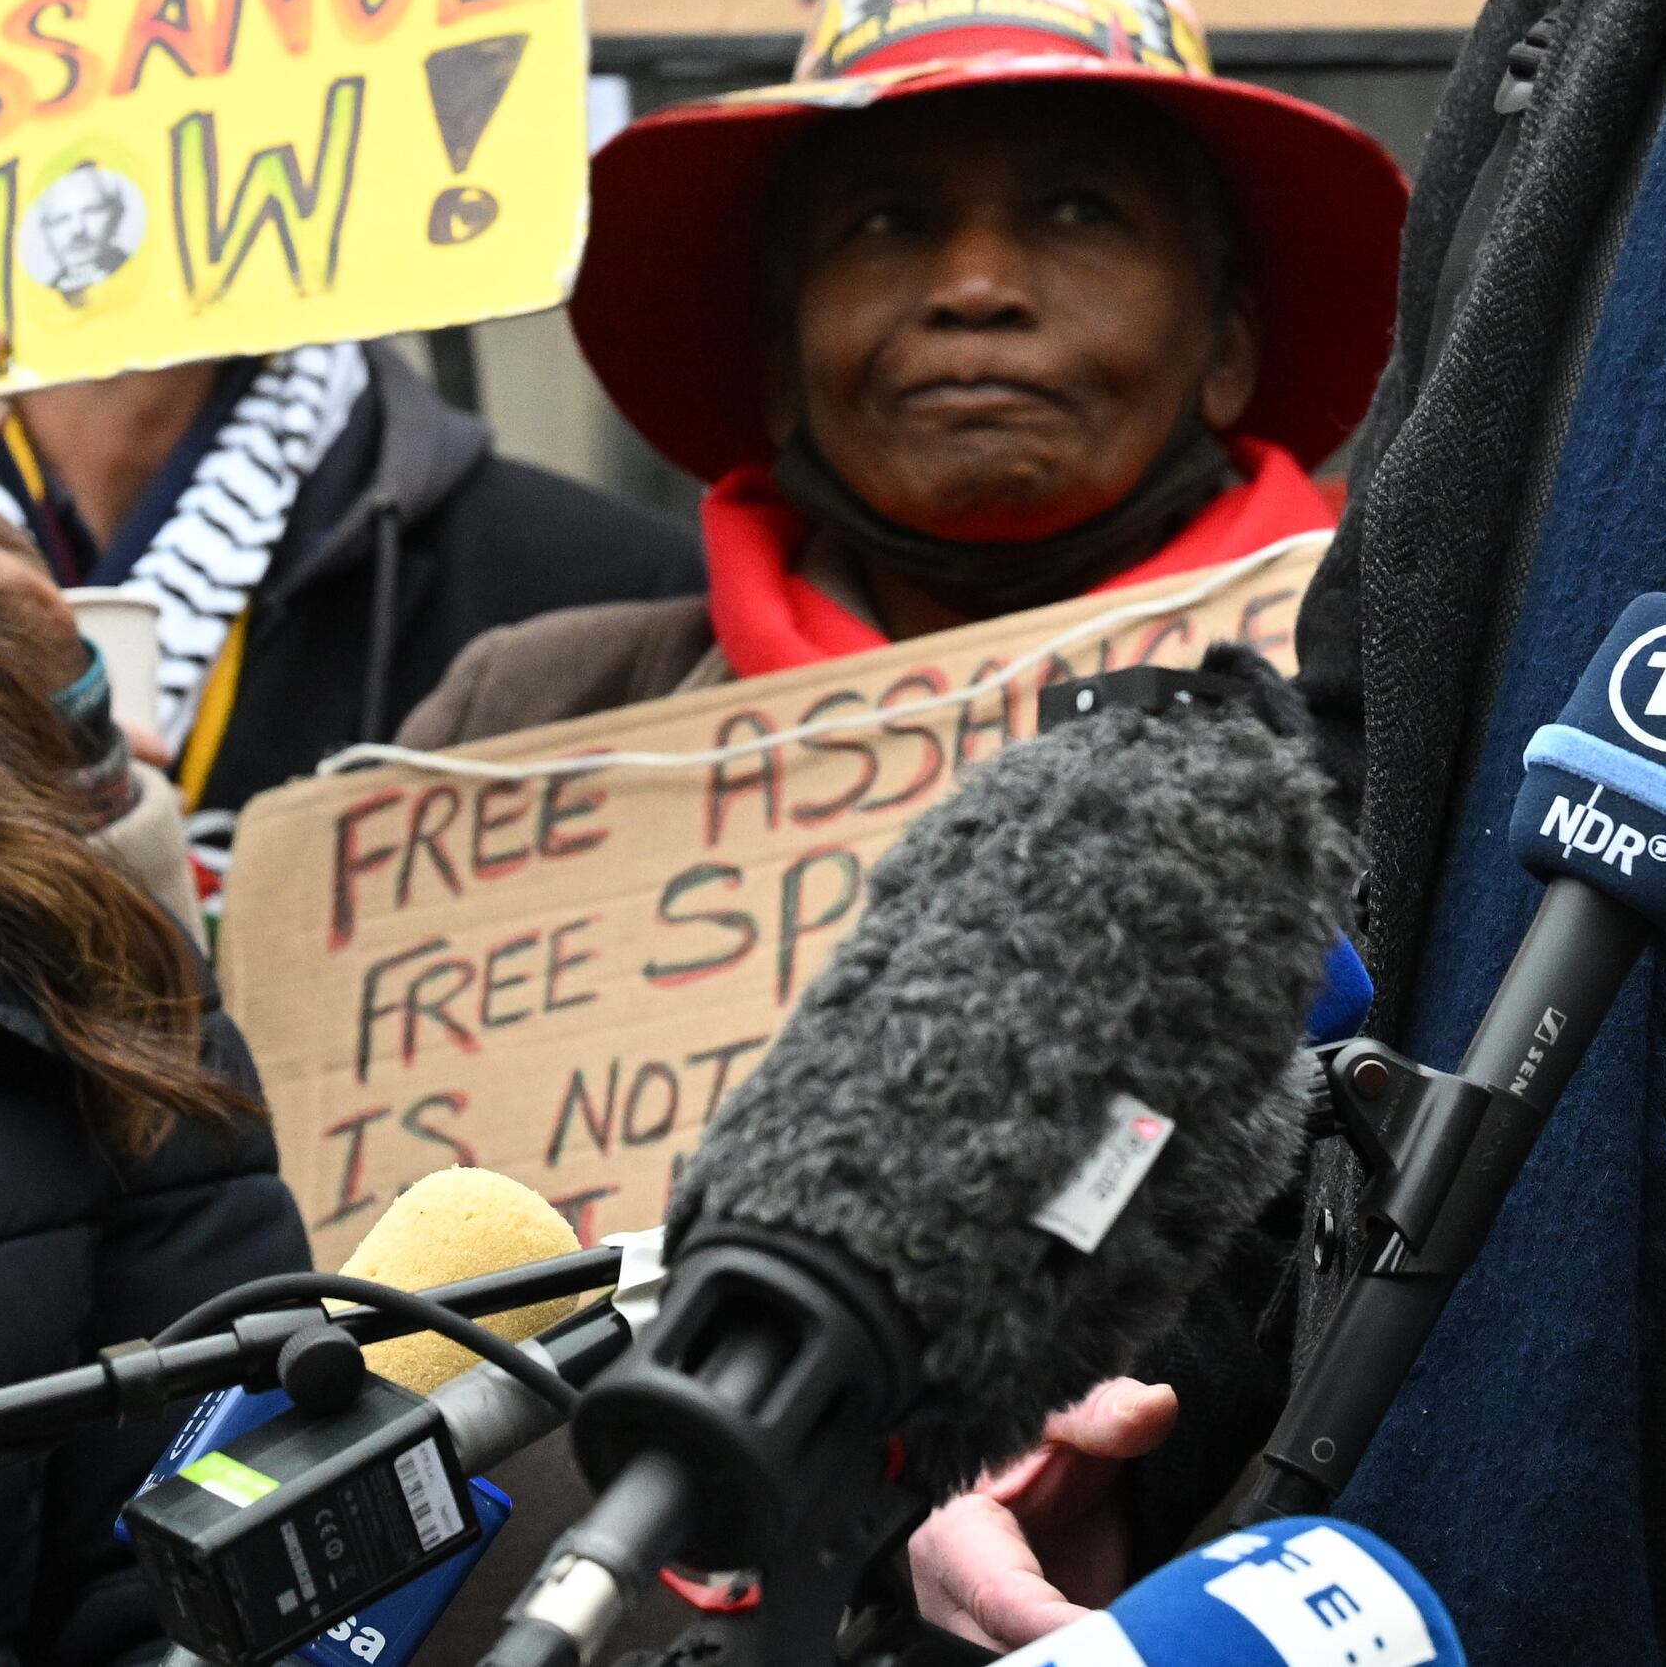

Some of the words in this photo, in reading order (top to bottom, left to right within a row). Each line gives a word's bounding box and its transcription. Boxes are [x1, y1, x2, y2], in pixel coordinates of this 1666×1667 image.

[328, 747, 616, 950] FREE
[1538, 784, 1648, 878] NDR
[356, 913, 599, 1084] FREE
[312, 1089, 479, 1232] IS
[544, 1043, 734, 1172] NOT
[324, 1615, 387, 1666] sa
